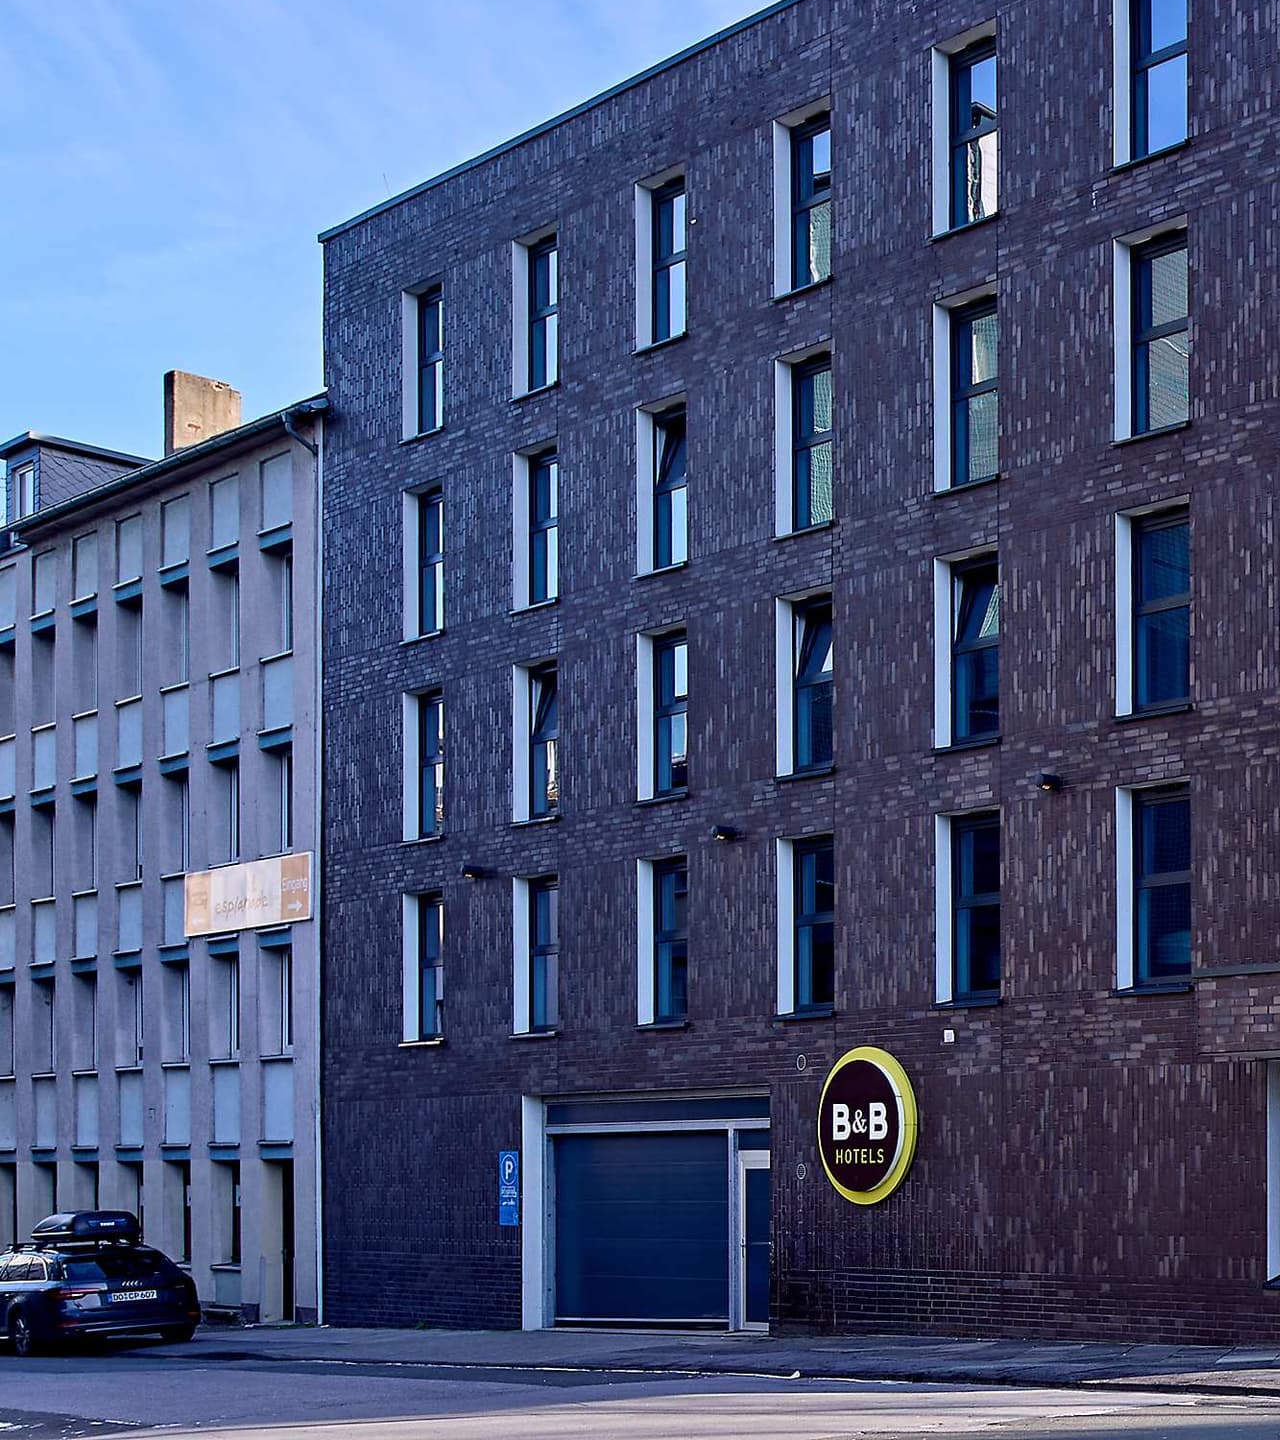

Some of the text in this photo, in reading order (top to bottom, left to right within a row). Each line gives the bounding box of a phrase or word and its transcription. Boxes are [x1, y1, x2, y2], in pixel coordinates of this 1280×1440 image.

[282, 876, 308, 892] Eingang
[832, 1102, 888, 1140] B&B
[835, 1148, 885, 1164] HOTELS
[505, 1160, 514, 1180] P
